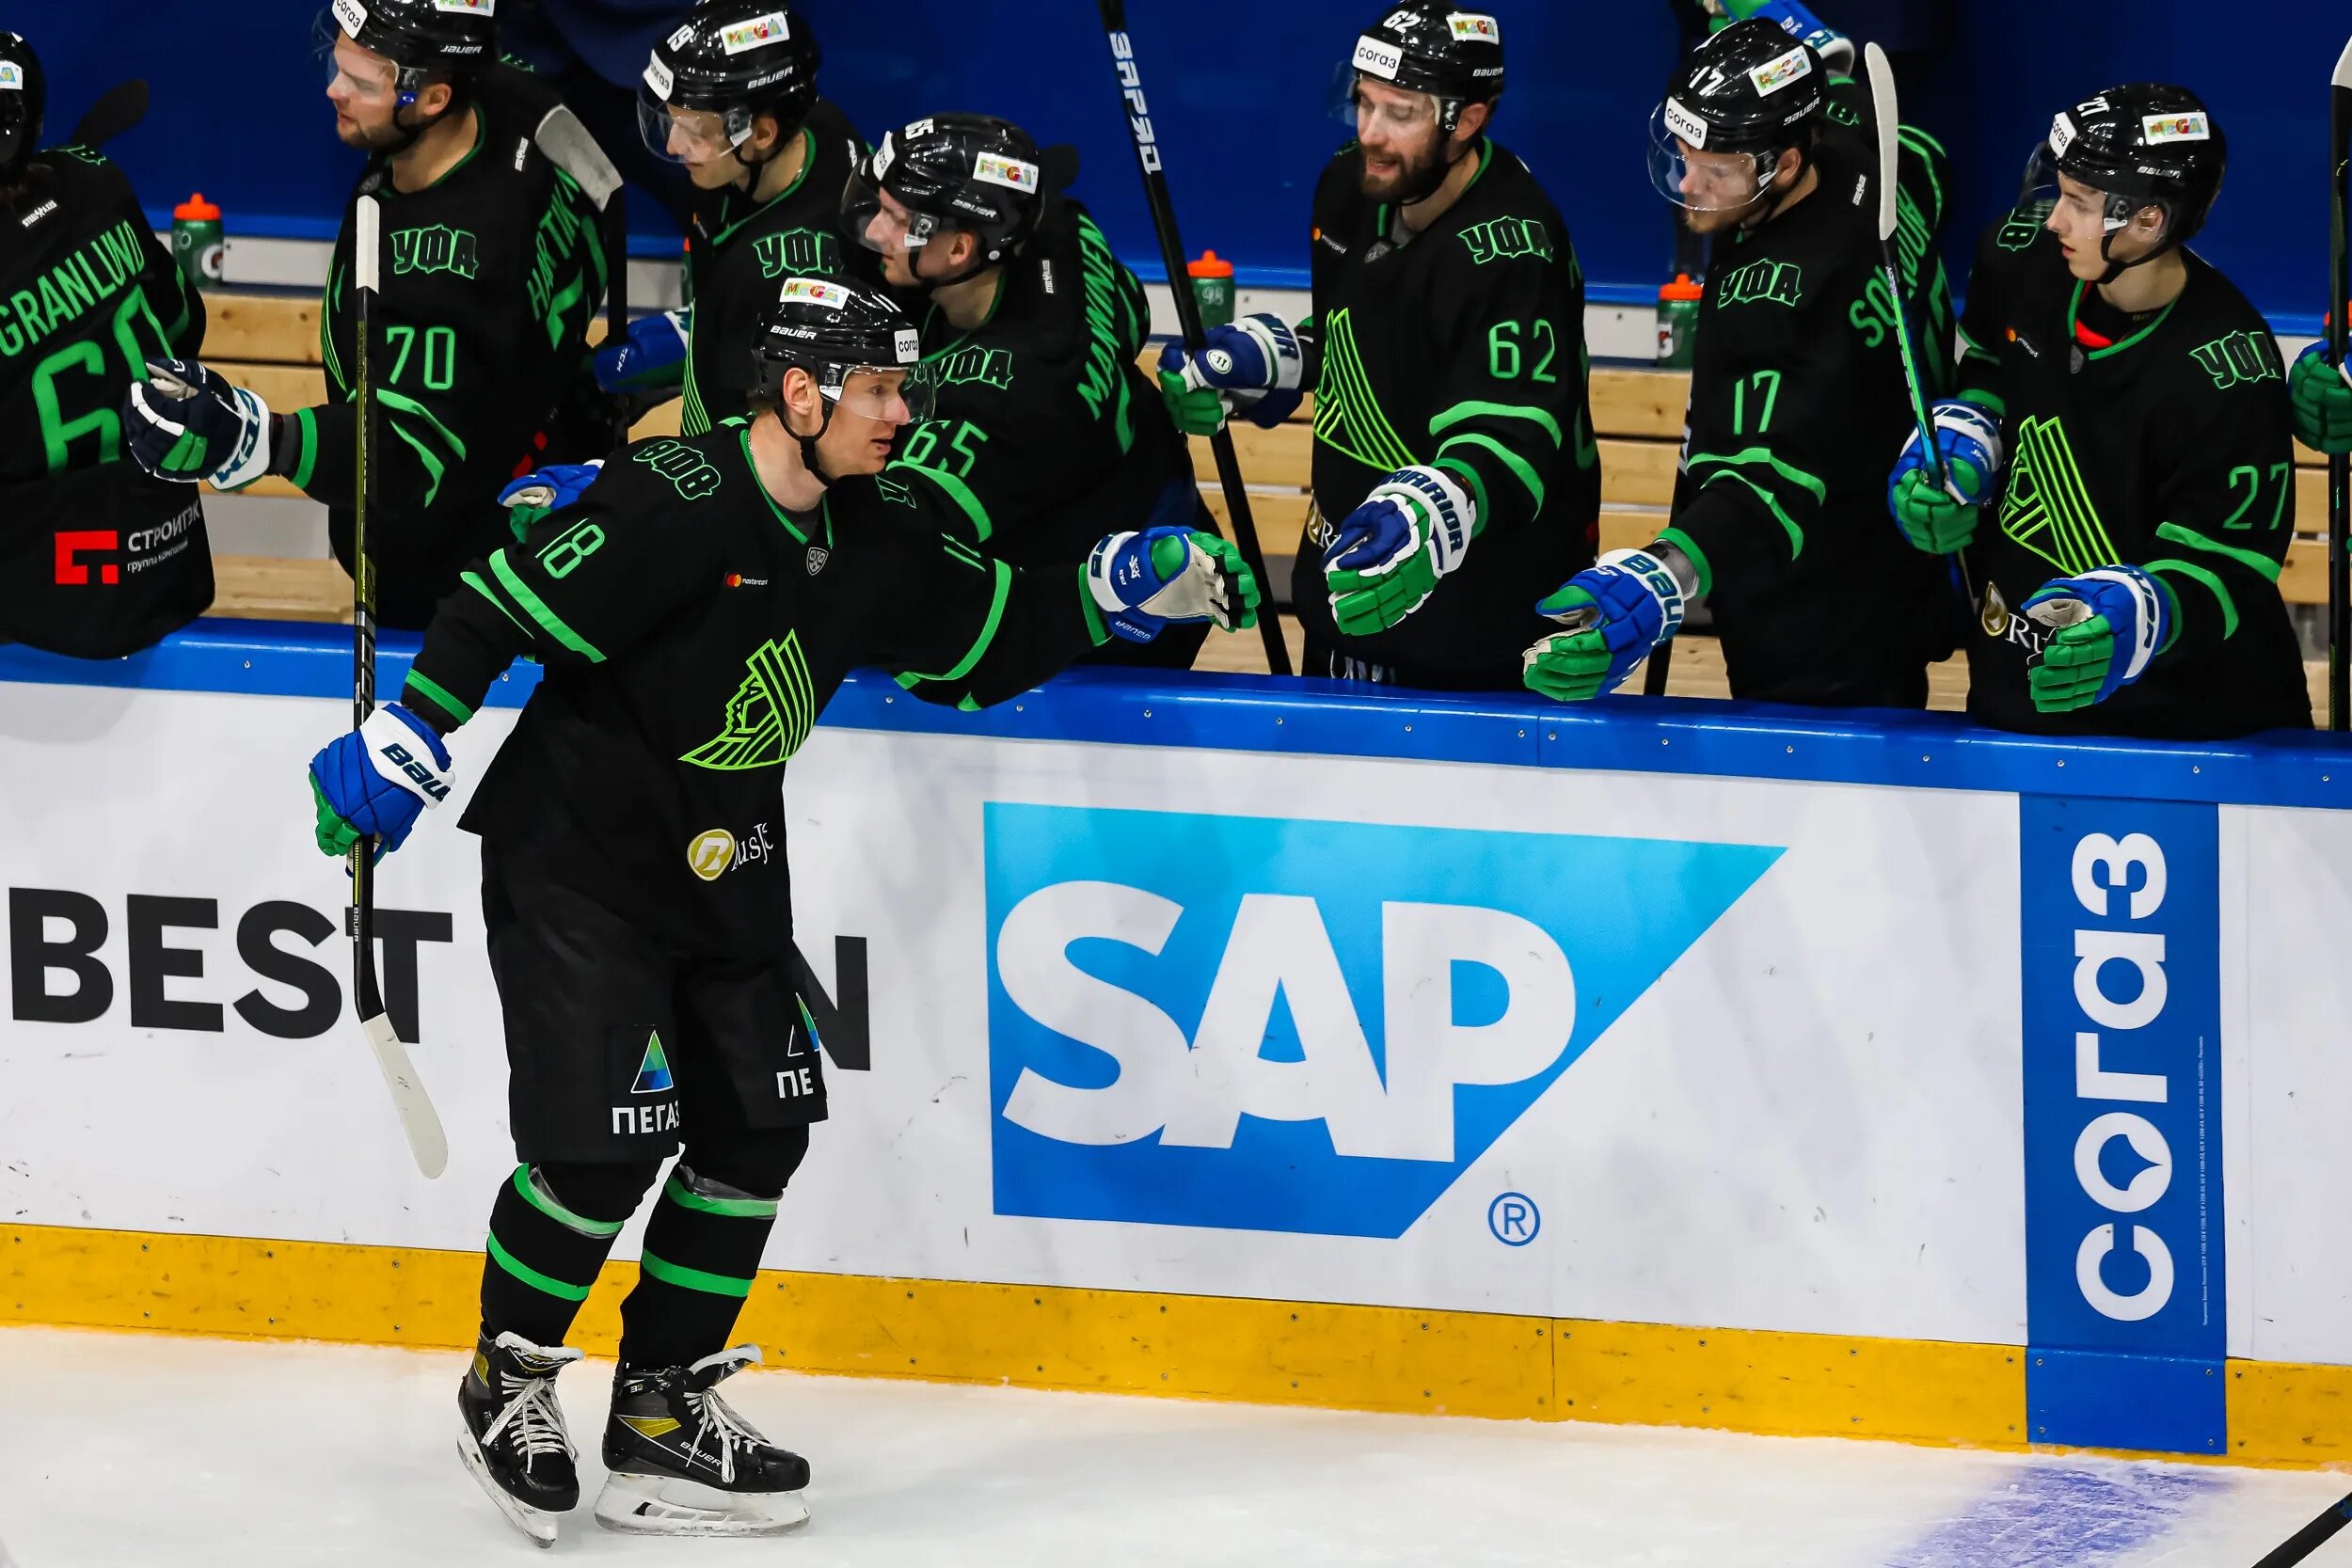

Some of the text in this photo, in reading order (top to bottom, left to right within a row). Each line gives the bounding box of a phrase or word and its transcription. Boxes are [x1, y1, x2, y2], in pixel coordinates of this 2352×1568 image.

[1383, 10, 1422, 34] 62
[1357, 47, 1398, 70] согаз
[1688, 66, 1725, 97] 17
[1666, 106, 1703, 140] согаз
[389, 224, 480, 279] УФА
[0, 219, 145, 356] GRANLUND
[387, 325, 456, 390] 70
[770, 325, 818, 341] BAUER
[1487, 318, 1556, 383] 62
[1733, 370, 1781, 436] 17
[902, 420, 989, 479] 65
[2222, 462, 2289, 531] 27
[534, 517, 606, 579] 18
[8, 886, 453, 1044] BEST
[997, 880, 1576, 1163] SAP
